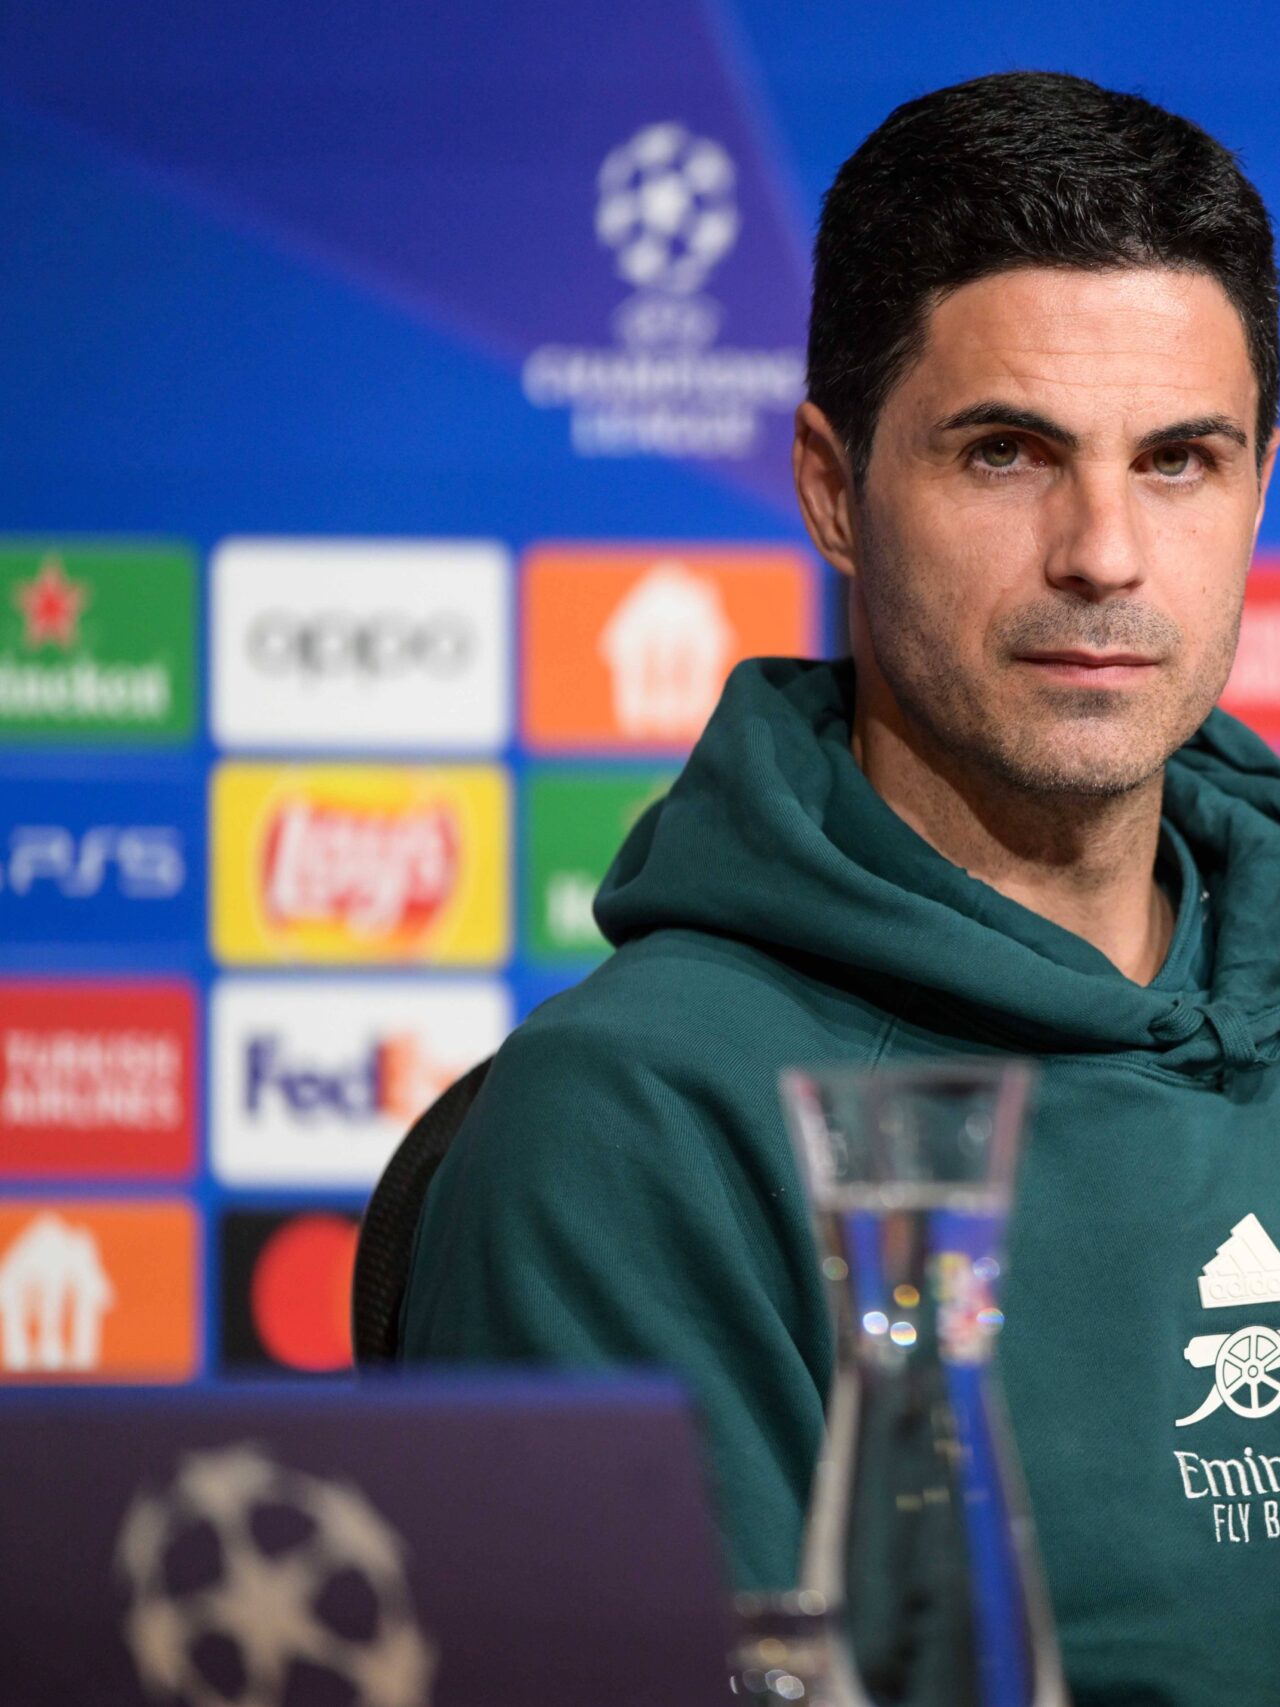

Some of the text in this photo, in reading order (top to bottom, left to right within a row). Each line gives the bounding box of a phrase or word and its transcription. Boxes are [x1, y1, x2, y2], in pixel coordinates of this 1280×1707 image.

[246, 605, 480, 685] oppo
[9, 826, 184, 897] PS5
[1213, 1502, 1250, 1543] FLY
